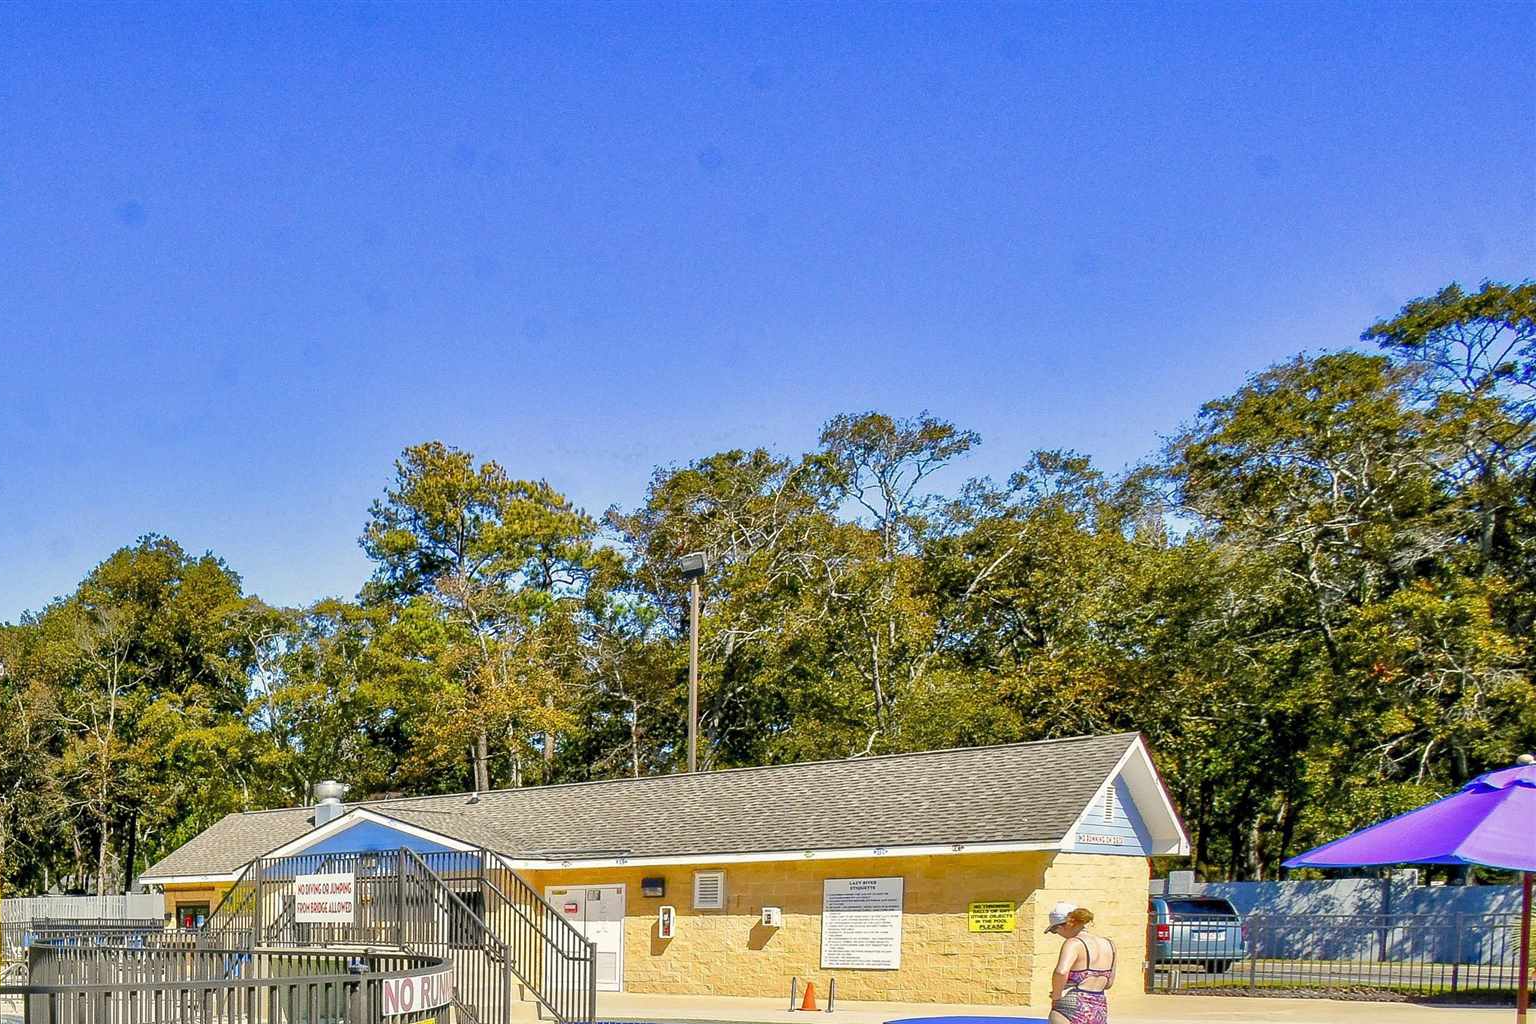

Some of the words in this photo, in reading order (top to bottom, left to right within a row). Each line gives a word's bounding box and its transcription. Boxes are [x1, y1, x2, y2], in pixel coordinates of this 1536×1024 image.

[297, 883, 305, 895] NO
[305, 883, 322, 895] DIVING
[322, 883, 330, 894] OR
[330, 882, 352, 894] JUMPING
[297, 902, 310, 913] FROM
[310, 902, 328, 913] BRIDGE
[328, 902, 352, 913] ALLOWED
[384, 977, 414, 1014] NO
